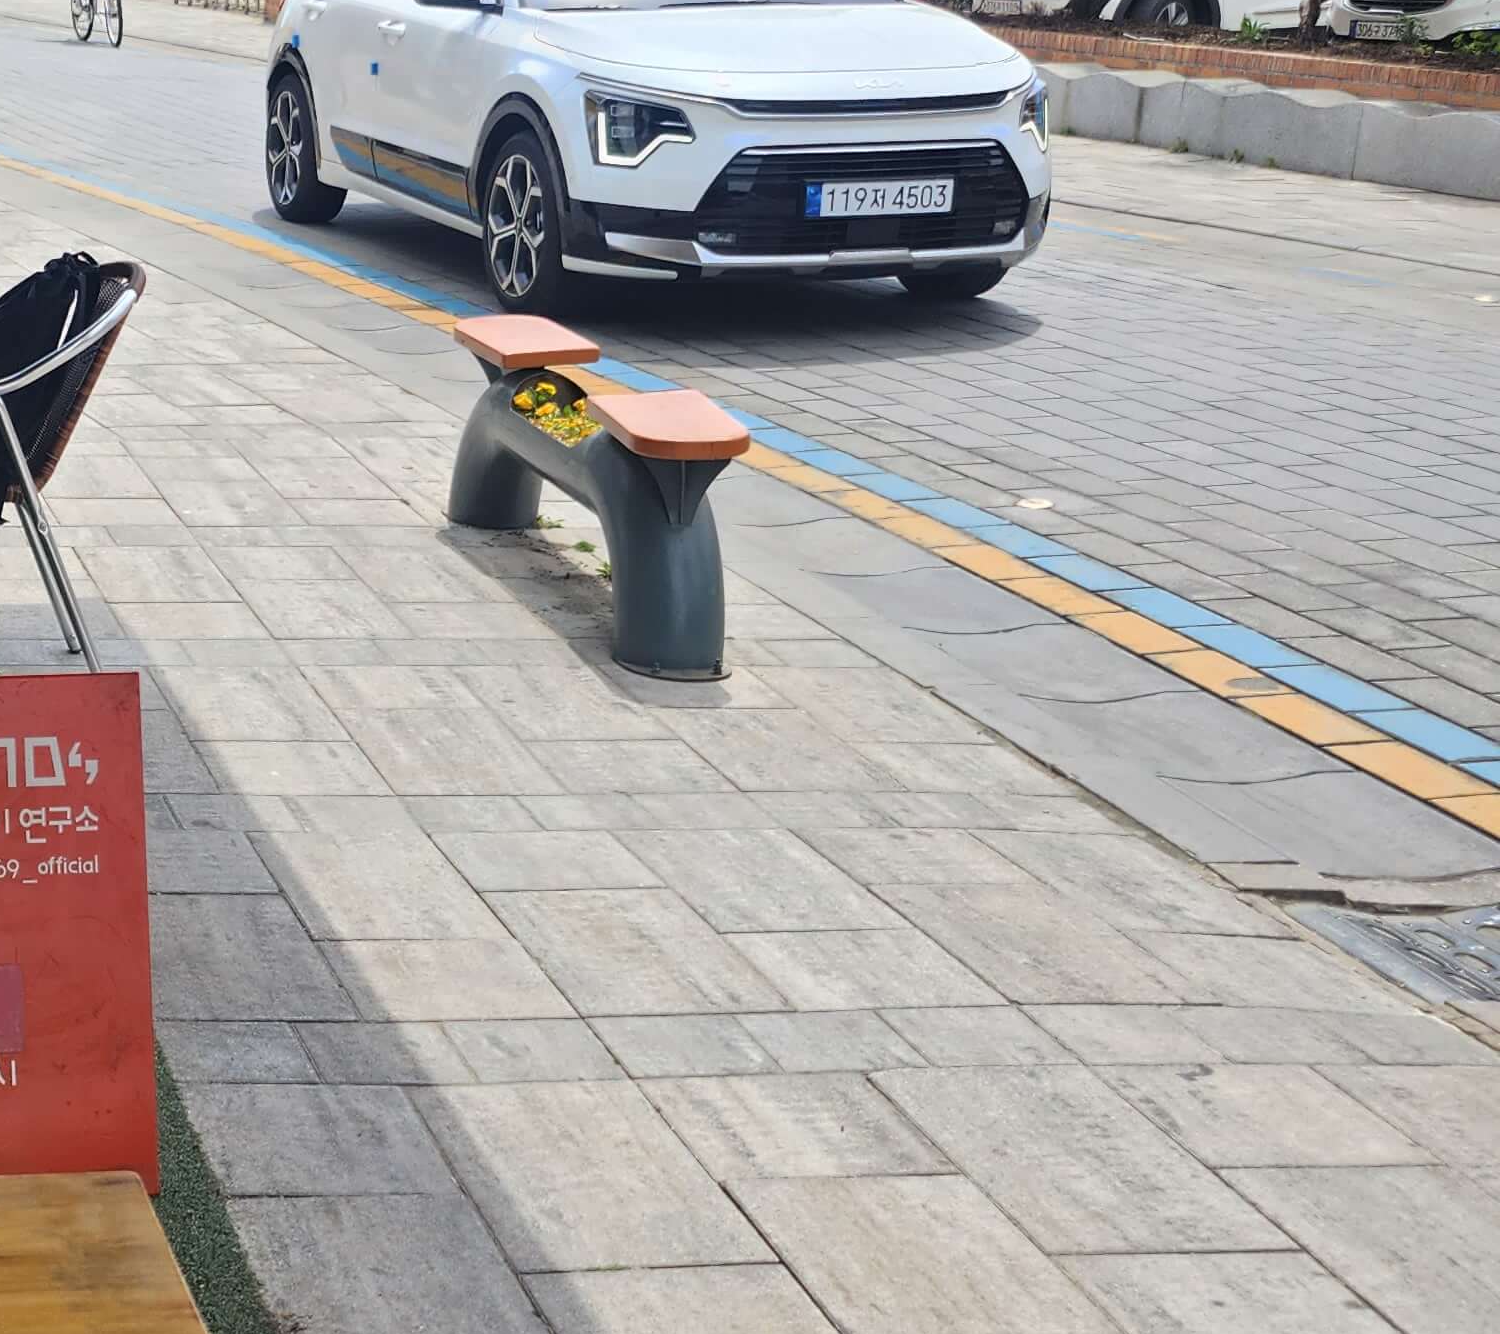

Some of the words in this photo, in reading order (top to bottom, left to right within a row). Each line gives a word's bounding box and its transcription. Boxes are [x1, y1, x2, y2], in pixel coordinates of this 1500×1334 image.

[826, 187, 886, 212] 119저
[891, 184, 949, 209] 4503
[19, 805, 99, 844] 연구소
